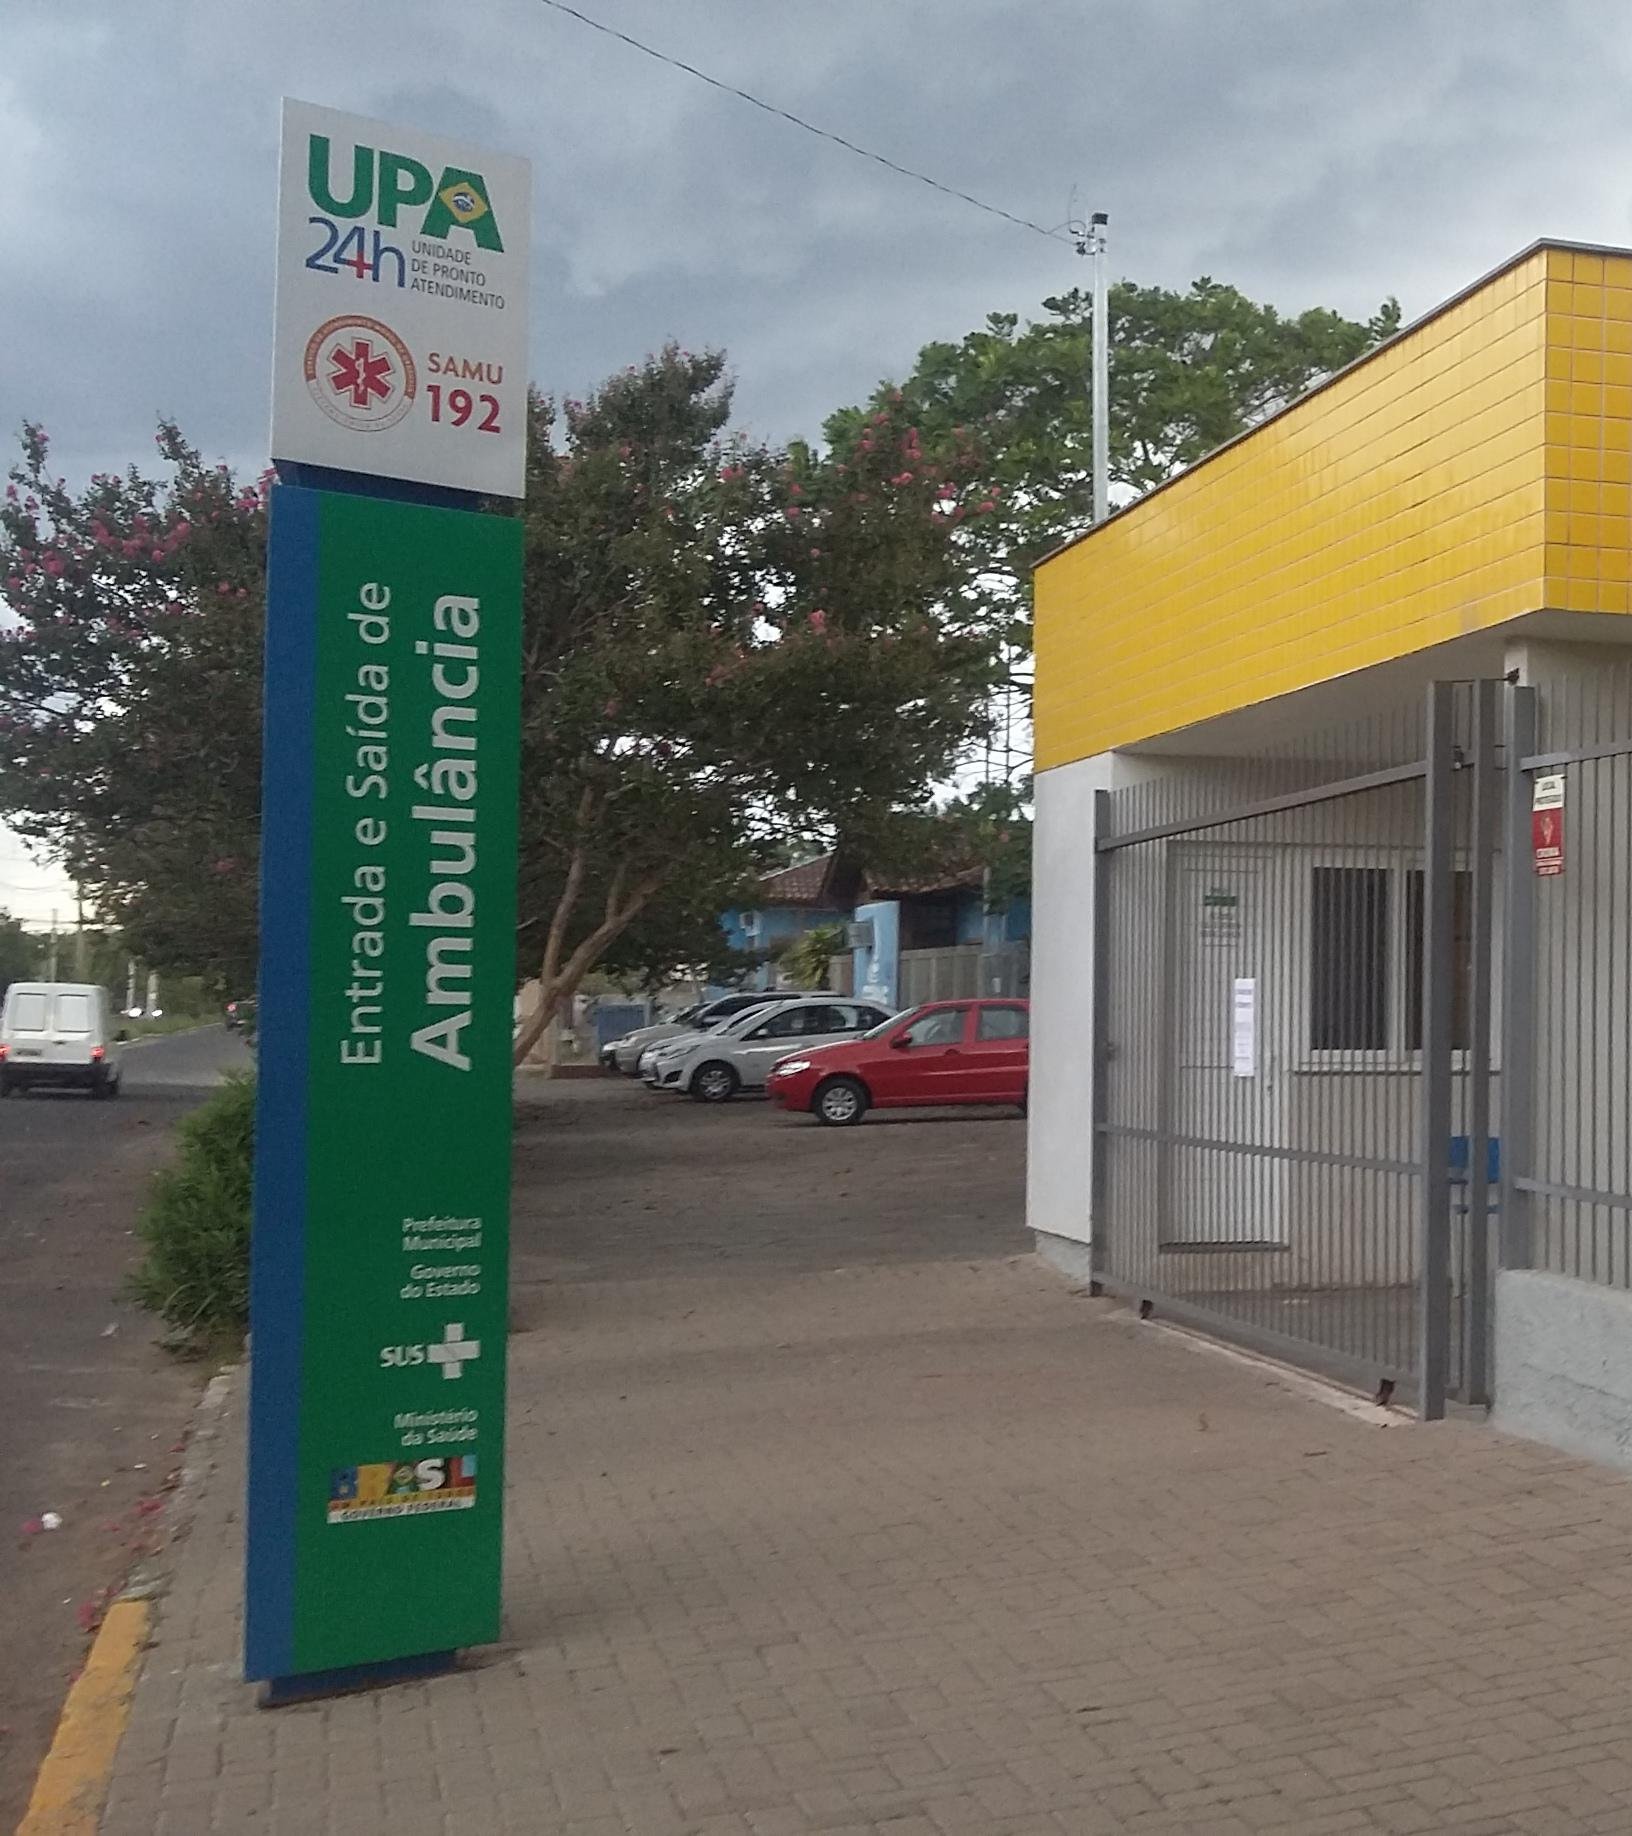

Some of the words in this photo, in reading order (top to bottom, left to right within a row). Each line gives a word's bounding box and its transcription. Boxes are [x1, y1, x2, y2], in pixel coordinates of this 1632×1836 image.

[308, 133, 504, 253] UPA
[305, 216, 405, 288] 24h
[412, 240, 471, 265] UNIDADE
[411, 258, 428, 274] DE
[433, 263, 486, 287] PRONTO
[411, 277, 505, 309] ATENDIMENTO
[427, 352, 504, 384] SAMU
[426, 384, 501, 434] 192
[346, 581, 391, 645] de
[344, 662, 389, 800] Saída
[355, 816, 387, 846] e
[408, 594, 480, 1072] Ambulância
[340, 864, 386, 1065] Entrada
[402, 1216, 481, 1232] Prefeitura
[402, 1232, 482, 1252] Municipal
[410, 1264, 481, 1280] Governo
[400, 1283, 424, 1299] do
[425, 1280, 481, 1297] Estado
[380, 1344, 425, 1368] SUS
[393, 1407, 479, 1429] Ministério
[401, 1430, 425, 1446] da
[426, 1425, 478, 1444] Saúde
